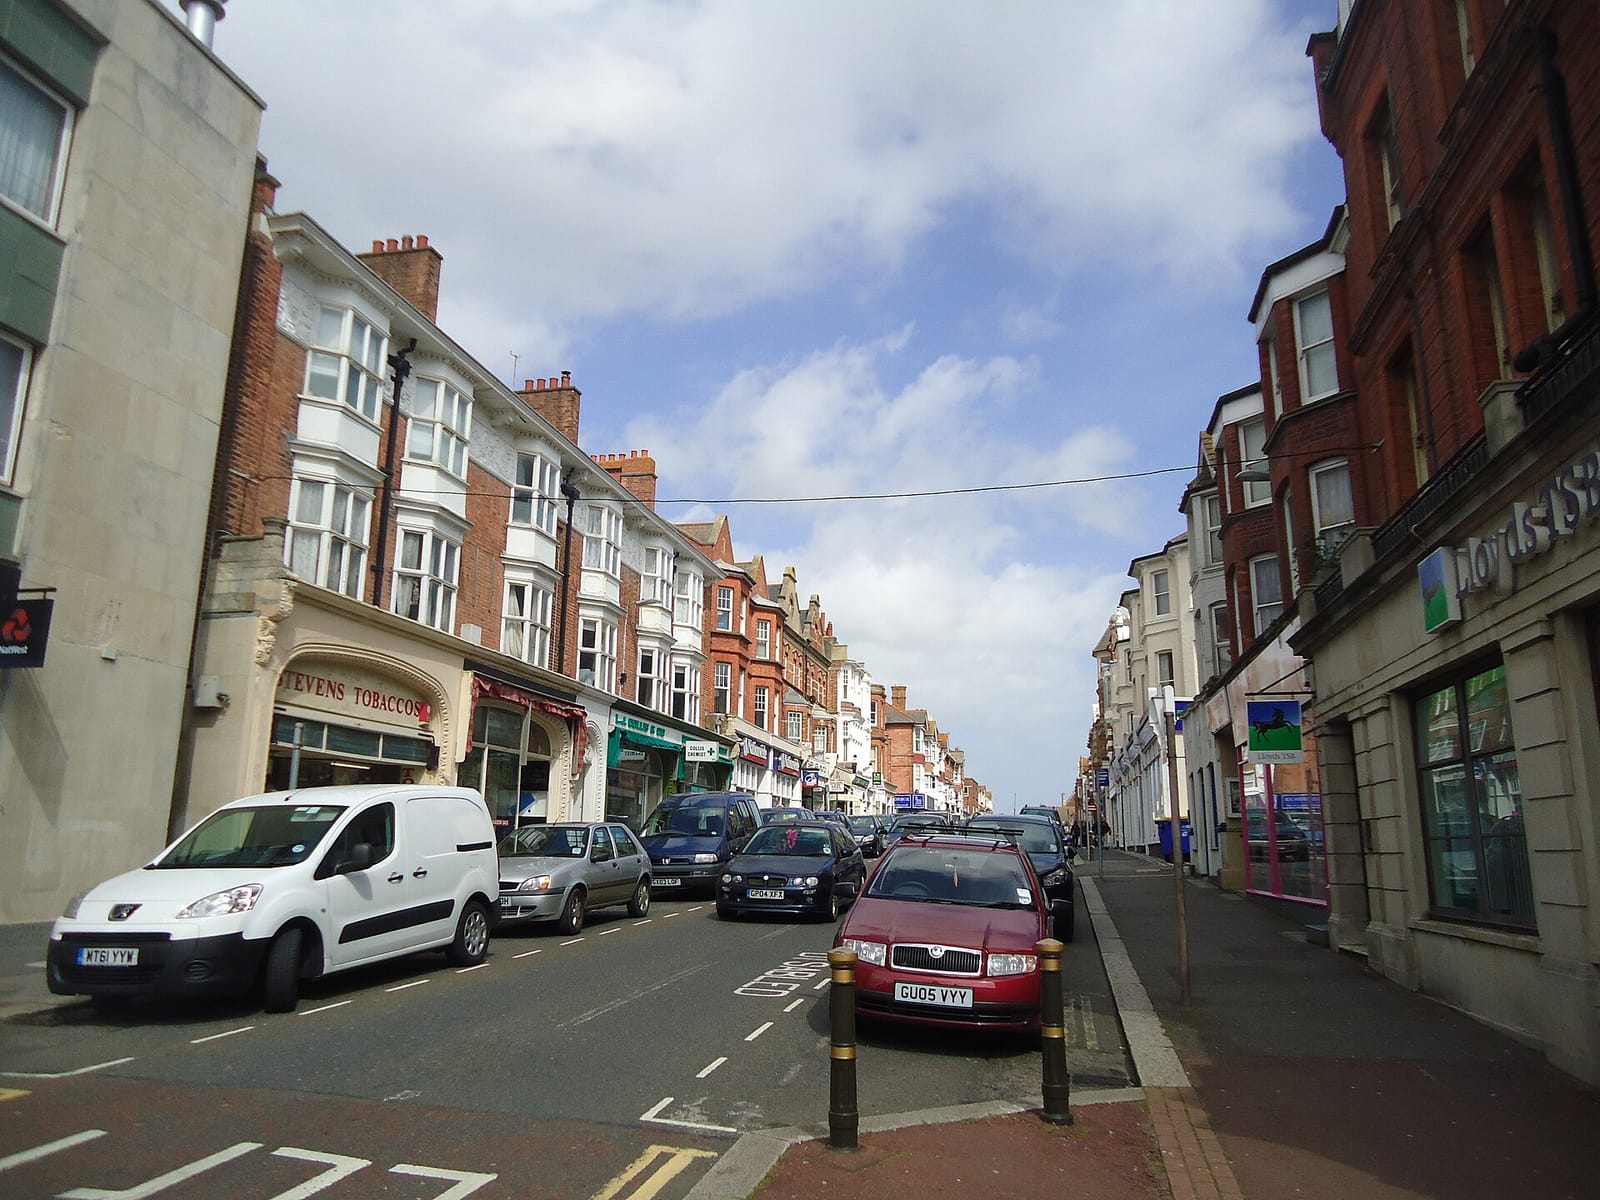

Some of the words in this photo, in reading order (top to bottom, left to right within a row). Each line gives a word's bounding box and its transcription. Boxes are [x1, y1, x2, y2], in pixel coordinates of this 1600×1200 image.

[1452, 502, 1540, 600] Lloyds
[1539, 451, 1600, 543] TSB
[354, 687, 421, 717] TOBACCOS
[1256, 752, 1280, 760] Lloyds
[1281, 752, 1296, 760] TSB
[733, 951, 831, 997] DISABLED
[901, 985, 936, 1002] GU05
[940, 989, 967, 1004] VYY
